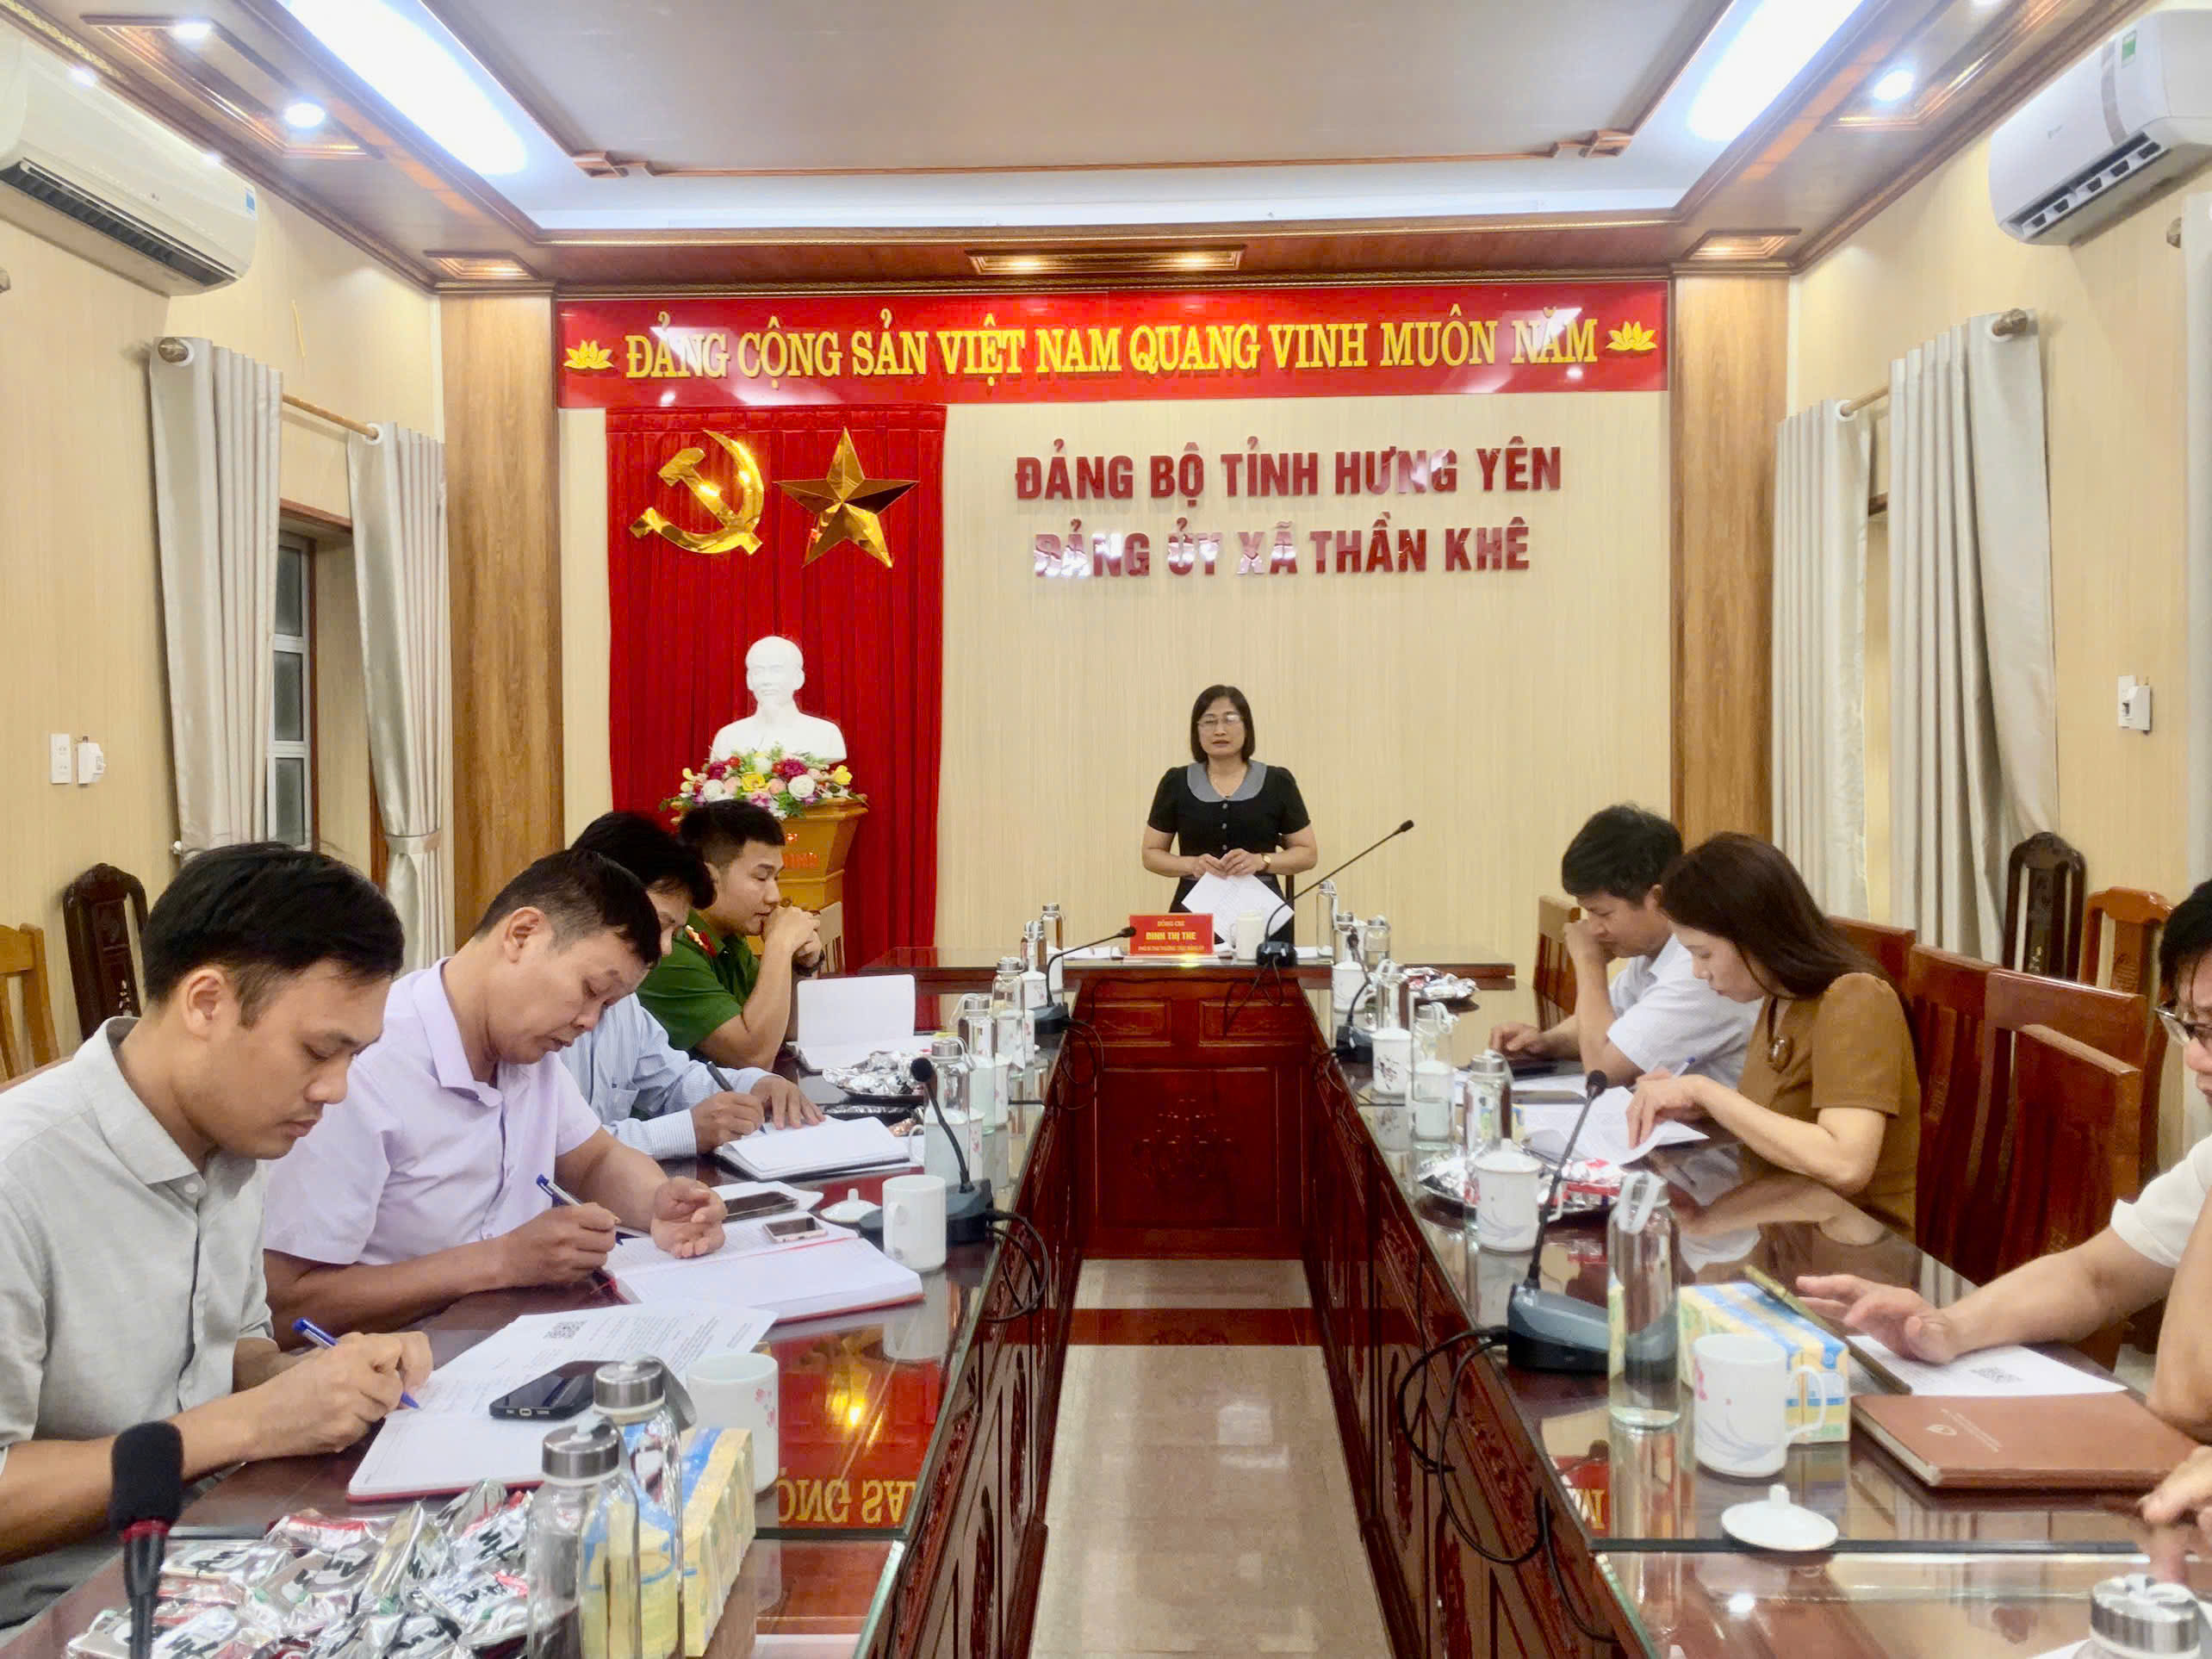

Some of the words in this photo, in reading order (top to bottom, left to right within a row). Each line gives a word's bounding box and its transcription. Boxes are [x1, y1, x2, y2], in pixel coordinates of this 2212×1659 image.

[625, 311, 730, 378] ĐẢNG
[738, 316, 842, 388] CỘNG
[853, 308, 928, 376] SẢN
[935, 314, 1025, 387] VIỆT
[1035, 327, 1122, 374] NAM
[1129, 324, 1261, 375] QUANG
[1268, 321, 1368, 369] VINH
[1380, 304, 1498, 366] MUÔN
[1511, 307, 1598, 364] NĂM
[1016, 438, 1134, 500] ĐẢNG
[1151, 442, 1204, 506] BỘ
[1221, 436, 1319, 498] TỈNH
[1335, 445, 1457, 495] HƯNG
[1476, 436, 1561, 492] YÊN
[1034, 519, 1151, 576] ĐẢNG
[1168, 517, 1223, 575] ỦY
[1236, 520, 1298, 575] XÃ
[1310, 511, 1427, 573] THẦN
[1445, 516, 1530, 571] KHÊ
